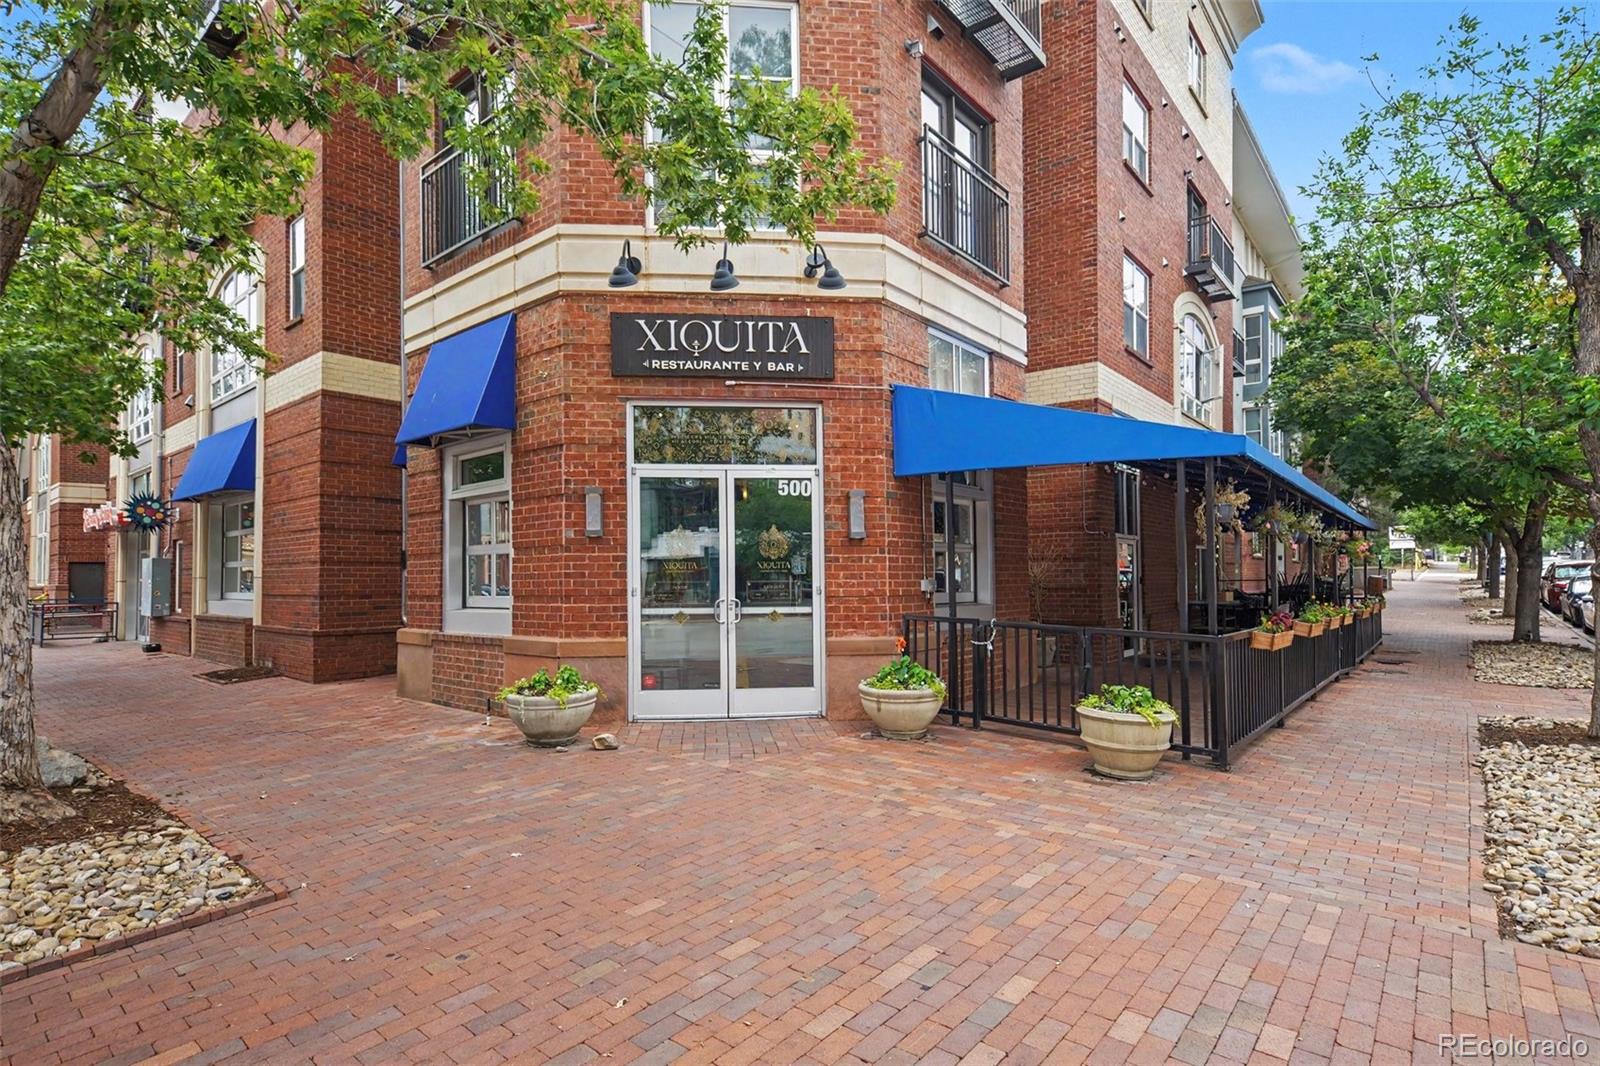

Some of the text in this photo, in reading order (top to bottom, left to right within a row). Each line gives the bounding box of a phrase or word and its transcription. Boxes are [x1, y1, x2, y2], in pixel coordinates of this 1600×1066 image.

[635, 319, 810, 356] XIQUITA
[651, 359, 795, 372] RESTAURANTE Y BAR
[777, 479, 811, 497] 500
